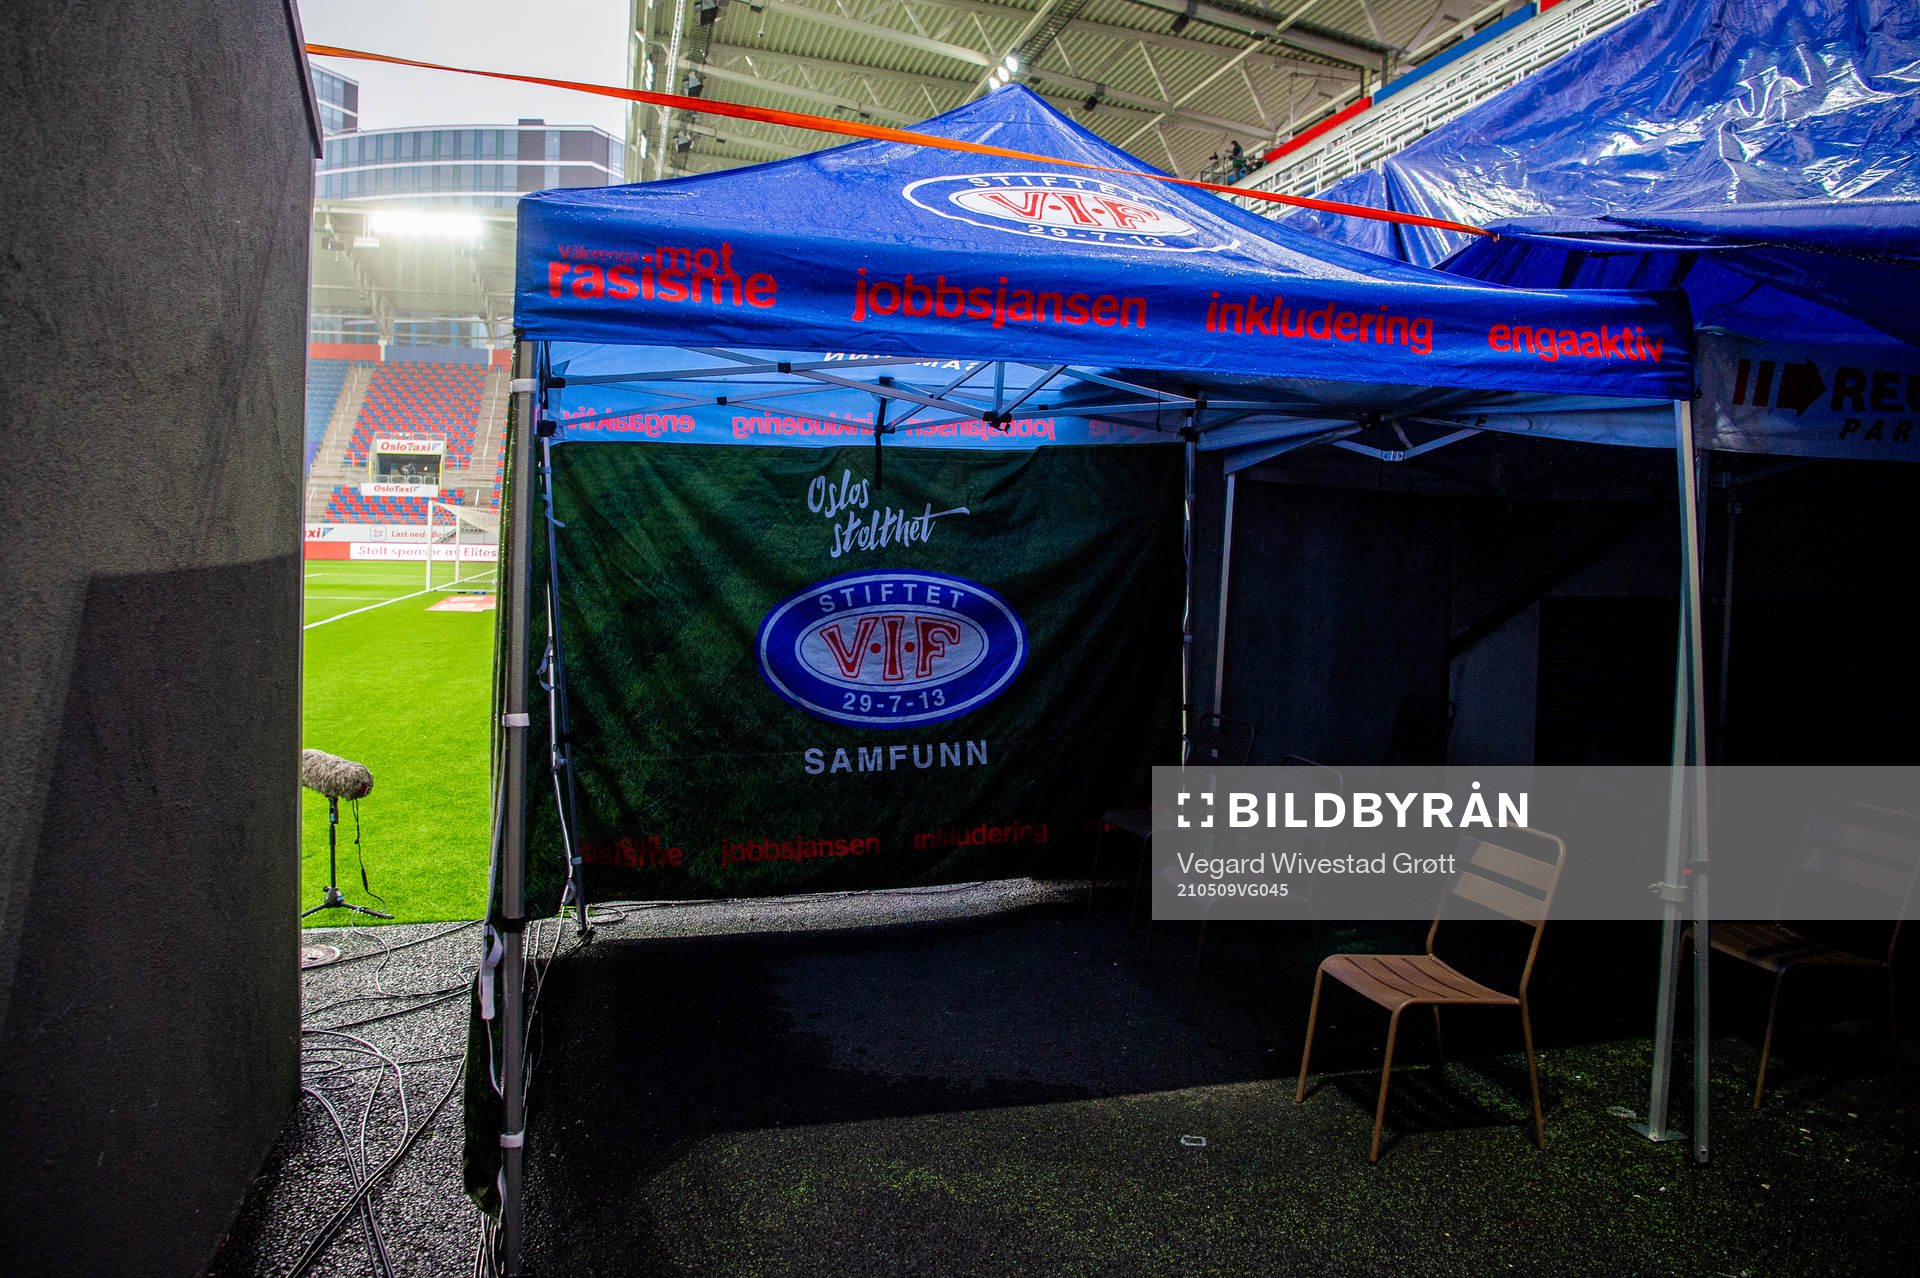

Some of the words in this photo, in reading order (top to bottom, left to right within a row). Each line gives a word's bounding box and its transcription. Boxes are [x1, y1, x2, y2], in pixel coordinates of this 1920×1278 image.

[1027, 224, 1167, 247] 29-7-13
[655, 241, 735, 276] mot
[547, 254, 779, 309] rasisme
[851, 267, 1148, 329] jobbsjansen
[1205, 291, 1434, 355] inkludering
[1487, 322, 1664, 363] engaaktiv
[380, 440, 431, 452] OsloTaxi
[373, 484, 413, 493] OsloTaxi
[807, 469, 870, 518] Oslos
[830, 502, 970, 558] stolthet
[358, 545, 388, 556] Stolt
[818, 582, 965, 613] STIFTET
[842, 688, 947, 714] 29-7-13
[803, 739, 989, 775] SAMFUNN
[720, 835, 880, 868] jobbsjansen
